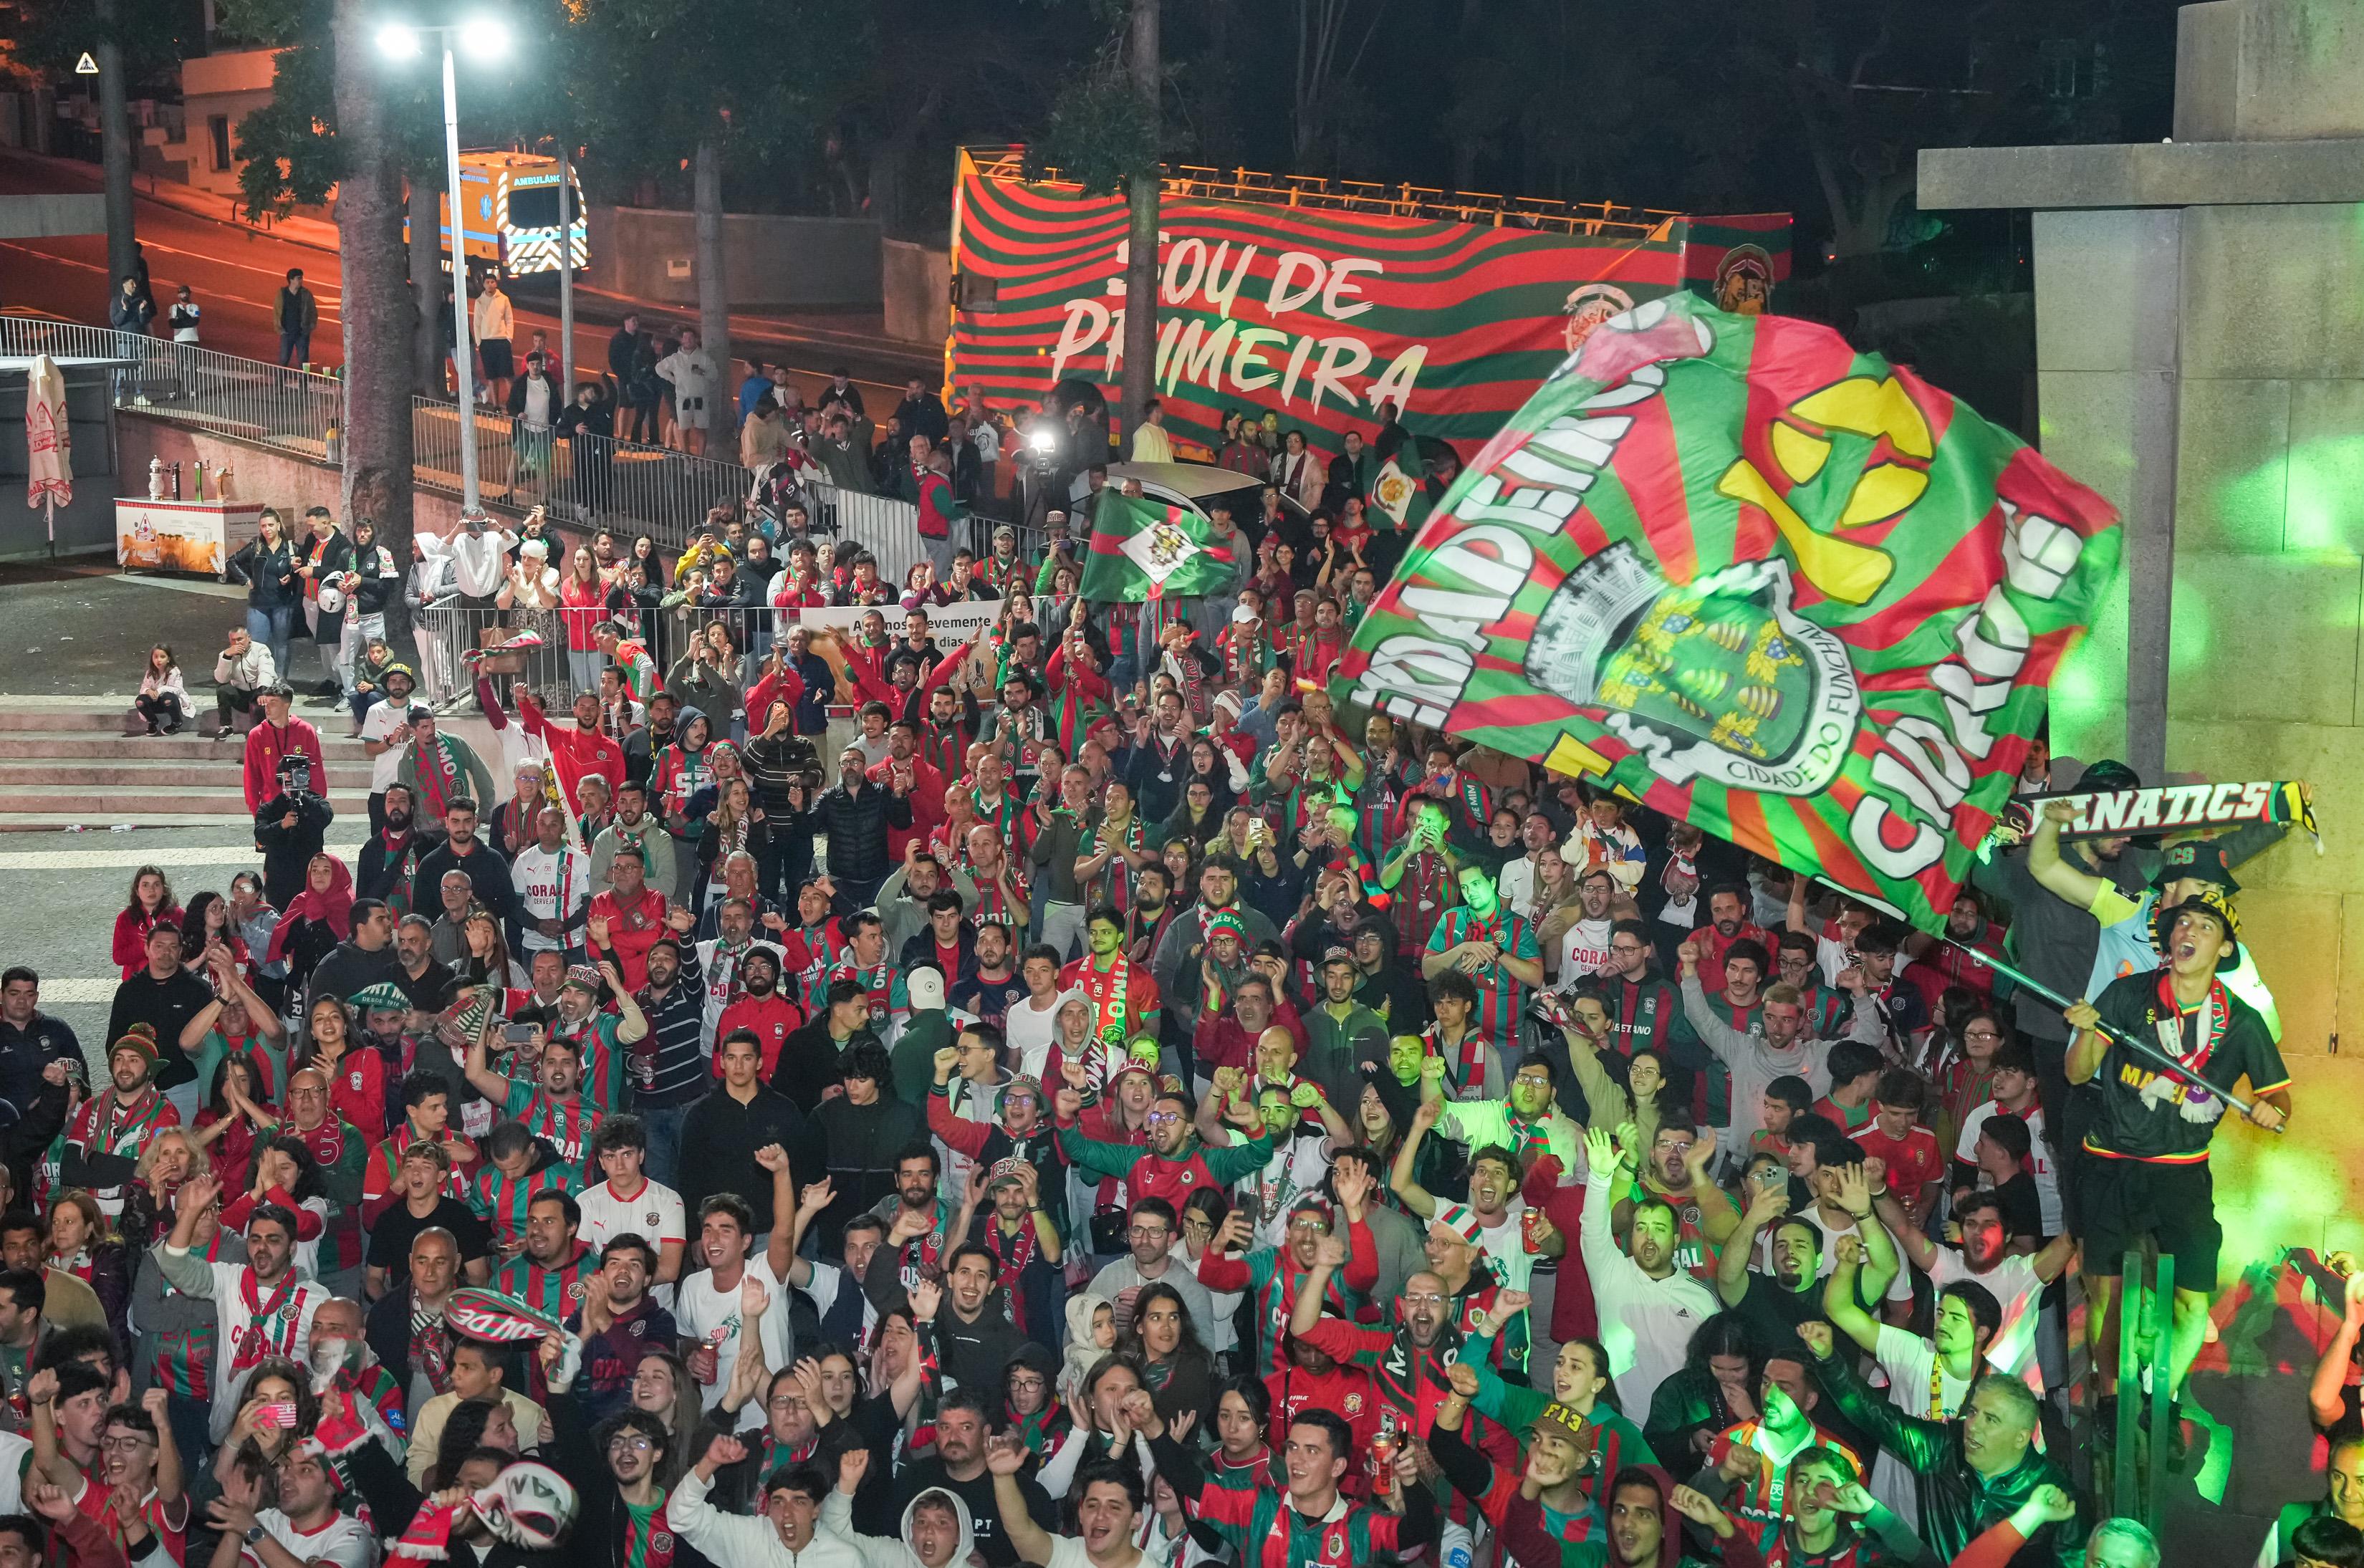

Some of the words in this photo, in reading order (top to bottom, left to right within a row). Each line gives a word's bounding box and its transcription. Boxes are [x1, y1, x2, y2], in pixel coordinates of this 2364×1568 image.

[514, 174, 570, 186] AMBULÂNC
[1264, 251, 1383, 320] DE
[927, 617, 991, 630] evemente
[1797, 624, 1853, 716] FUNCHAL
[1849, 496, 2083, 880] CIDADE
[1809, 722, 1842, 766] DO
[1726, 759, 1819, 787] CIDADE
[527, 883, 567, 898] CORAL
[1614, 1024, 1652, 1036] BETANO
[994, 1160, 1024, 1177] 192
[1542, 1403, 1583, 1433] F13
